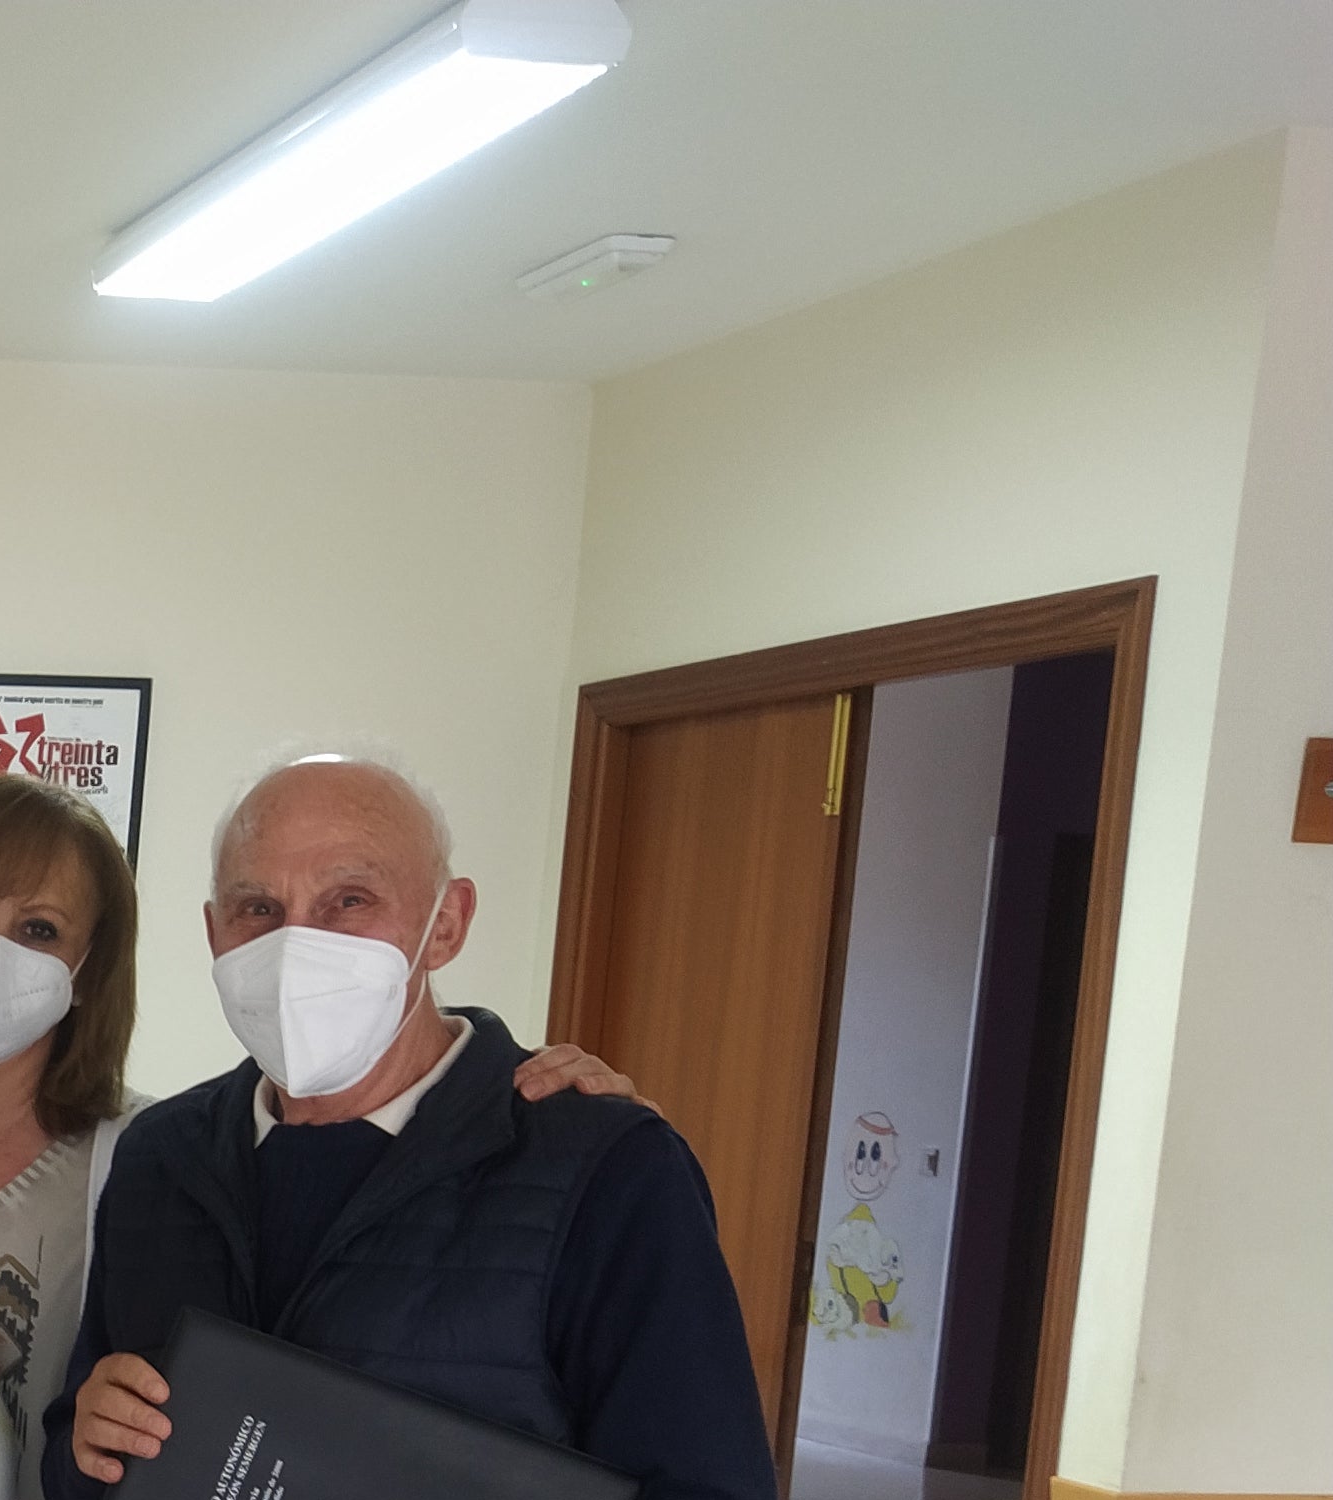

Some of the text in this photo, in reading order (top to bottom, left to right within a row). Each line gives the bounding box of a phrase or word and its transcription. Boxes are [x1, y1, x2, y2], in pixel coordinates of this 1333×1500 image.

[37, 737, 119, 765] treinta
[51, 762, 102, 787] tres
[216, 1416, 254, 1496] AUTONÓMICO
[236, 1421, 266, 1479] SEMERGEN
